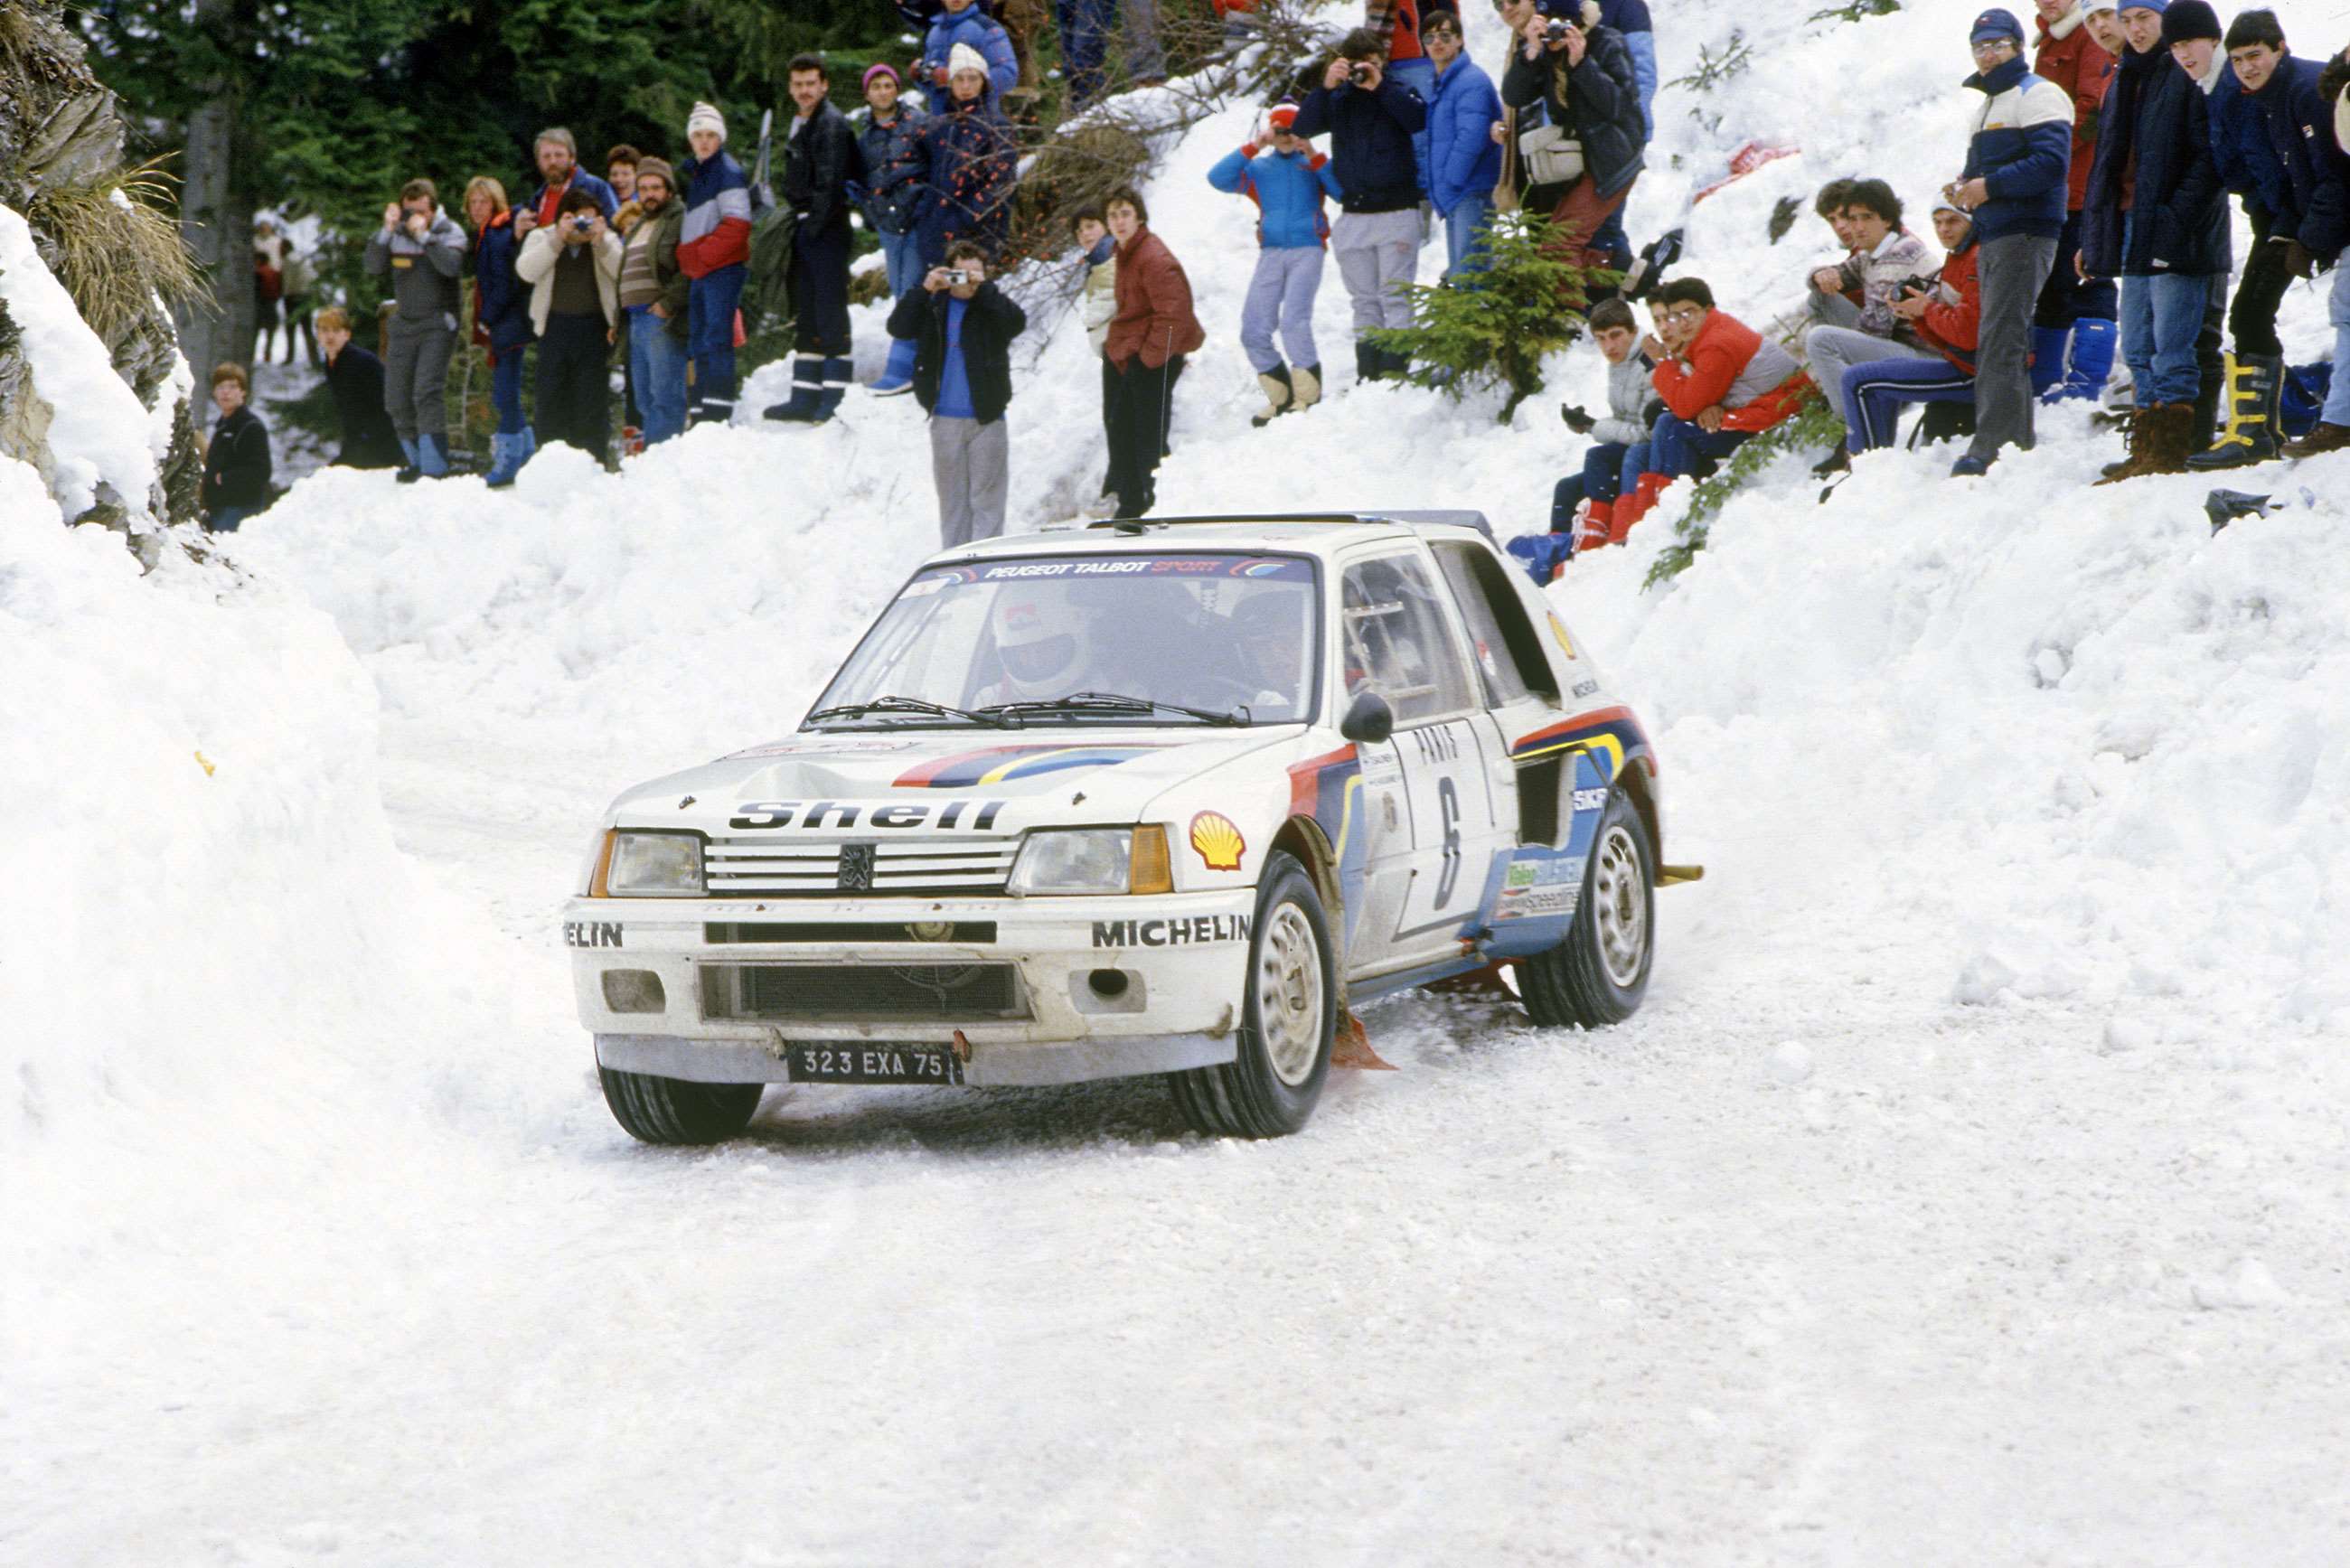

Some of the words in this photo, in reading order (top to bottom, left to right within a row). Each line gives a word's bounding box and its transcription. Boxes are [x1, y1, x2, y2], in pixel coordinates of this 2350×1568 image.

[985, 564, 1073, 578] PEUGEOT
[1073, 562, 1152, 575] TALBOT
[1152, 561, 1221, 573] SPORT
[728, 801, 1007, 830] Shell
[1092, 915, 1251, 947] MICHELIN
[804, 1051, 852, 1074] 323
[862, 1052, 905, 1075] EXA
[914, 1053, 942, 1075] 75
